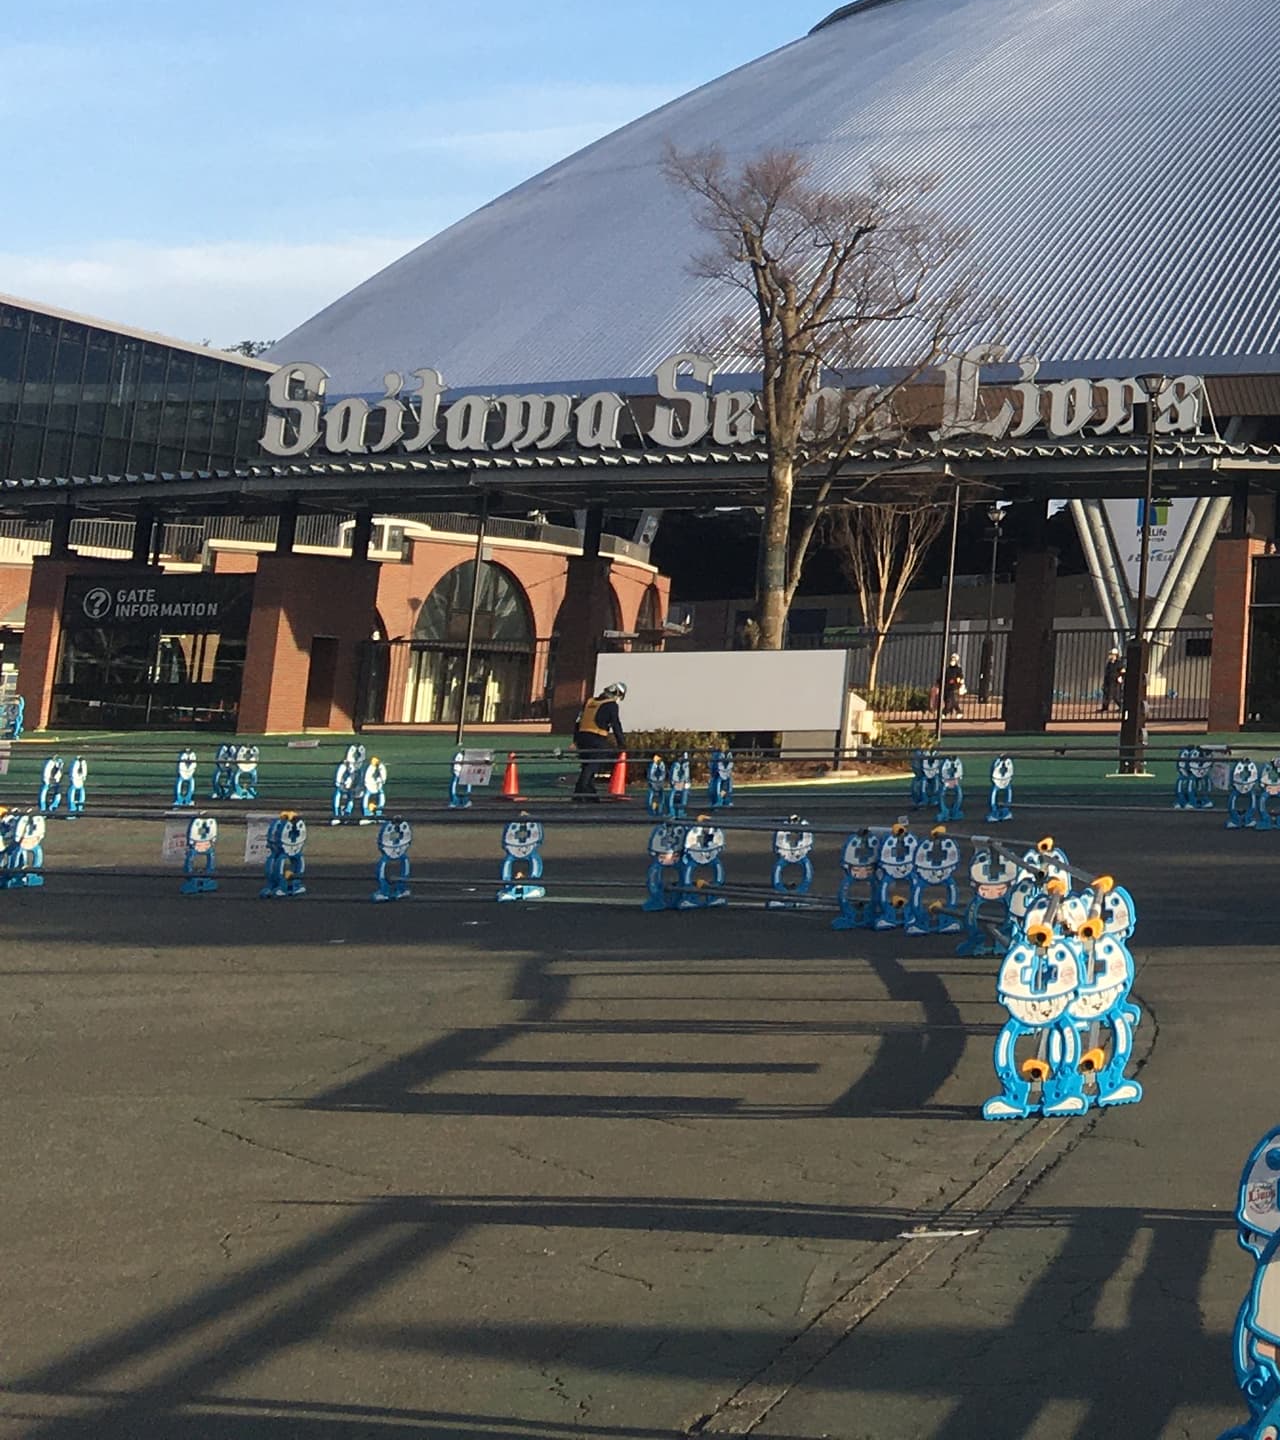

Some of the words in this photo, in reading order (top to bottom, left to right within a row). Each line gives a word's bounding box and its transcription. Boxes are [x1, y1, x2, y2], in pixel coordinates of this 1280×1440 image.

[258, 361, 627, 456] Saitama
[117, 589, 157, 603] GATE
[115, 602, 219, 617] INFORMATION
